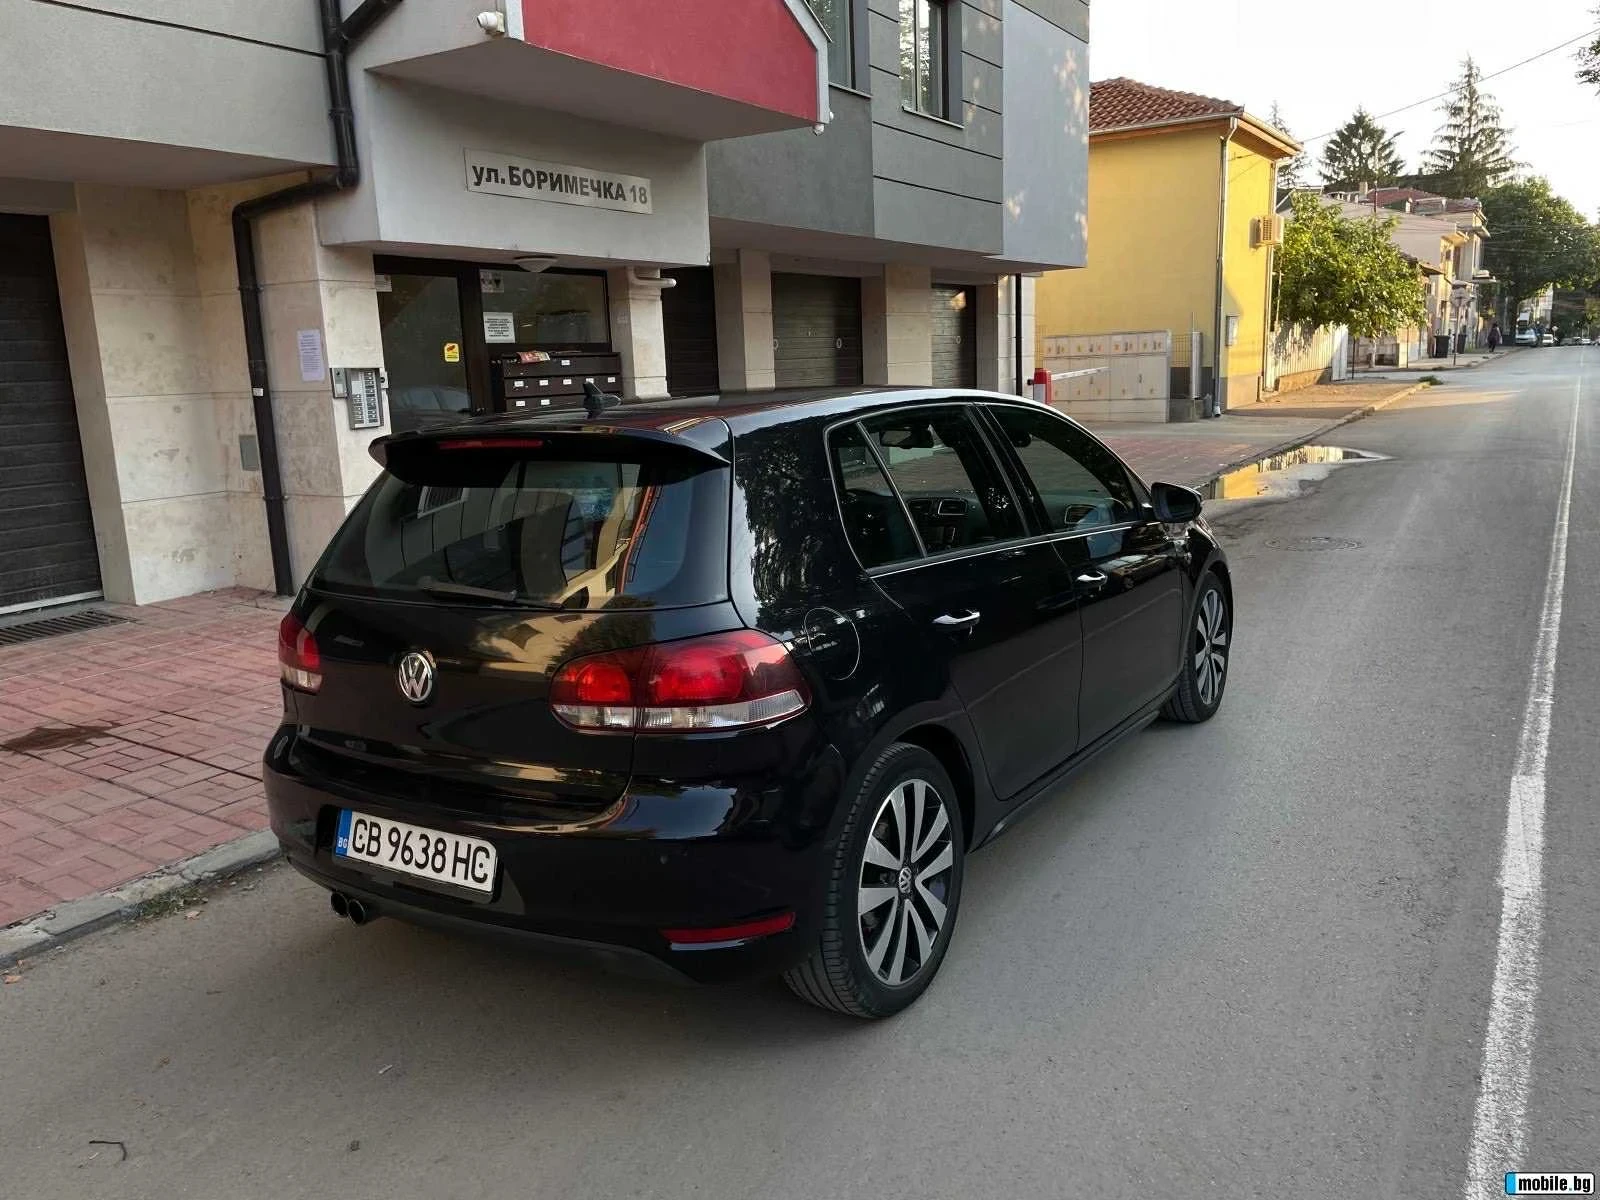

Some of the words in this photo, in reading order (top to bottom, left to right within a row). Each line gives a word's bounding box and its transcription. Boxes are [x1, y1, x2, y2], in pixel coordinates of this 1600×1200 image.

[629, 185, 648, 205] 18
[337, 836, 349, 848] BG
[352, 818, 382, 857] CB
[387, 826, 447, 874] 9638
[451, 840, 490, 884] HC
